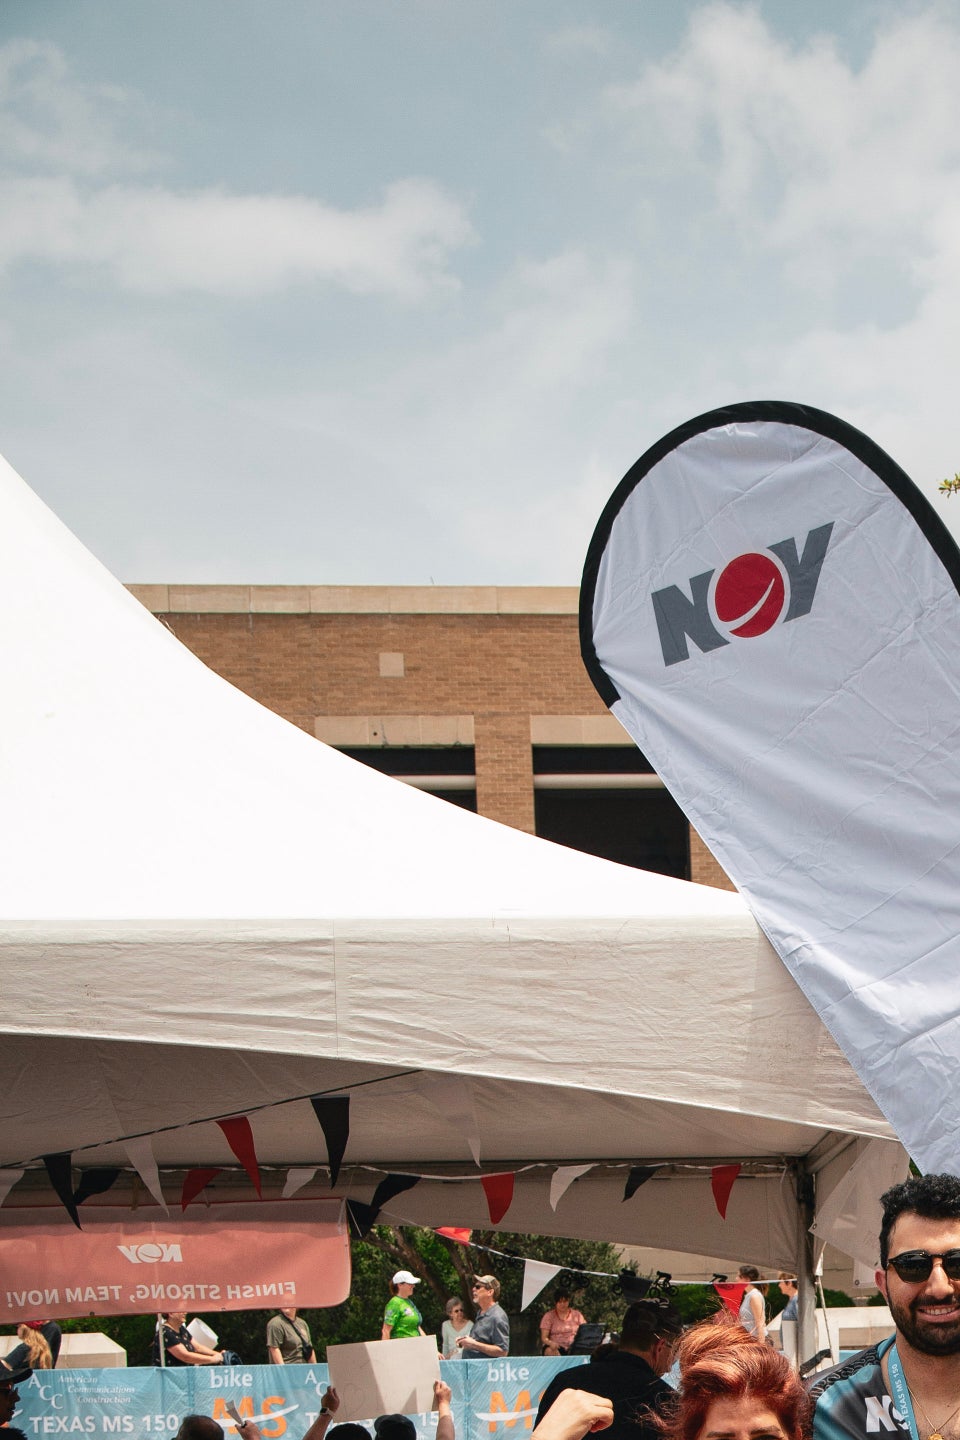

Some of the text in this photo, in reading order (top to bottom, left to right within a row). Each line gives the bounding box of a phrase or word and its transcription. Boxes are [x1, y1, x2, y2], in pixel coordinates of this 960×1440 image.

[651, 521, 835, 667] NOV
[59, 1375, 98, 1384] American
[210, 1369, 253, 1389] bike
[487, 1362, 530, 1382] bike
[28, 1373, 63, 1410] ACC
[68, 1385, 136, 1395] Communications
[304, 1369, 333, 1398] AC
[77, 1396, 131, 1404] Construction
[212, 1396, 287, 1438] MS
[488, 1390, 546, 1433] M
[29, 1414, 179, 1434] TEXAS MS 150
